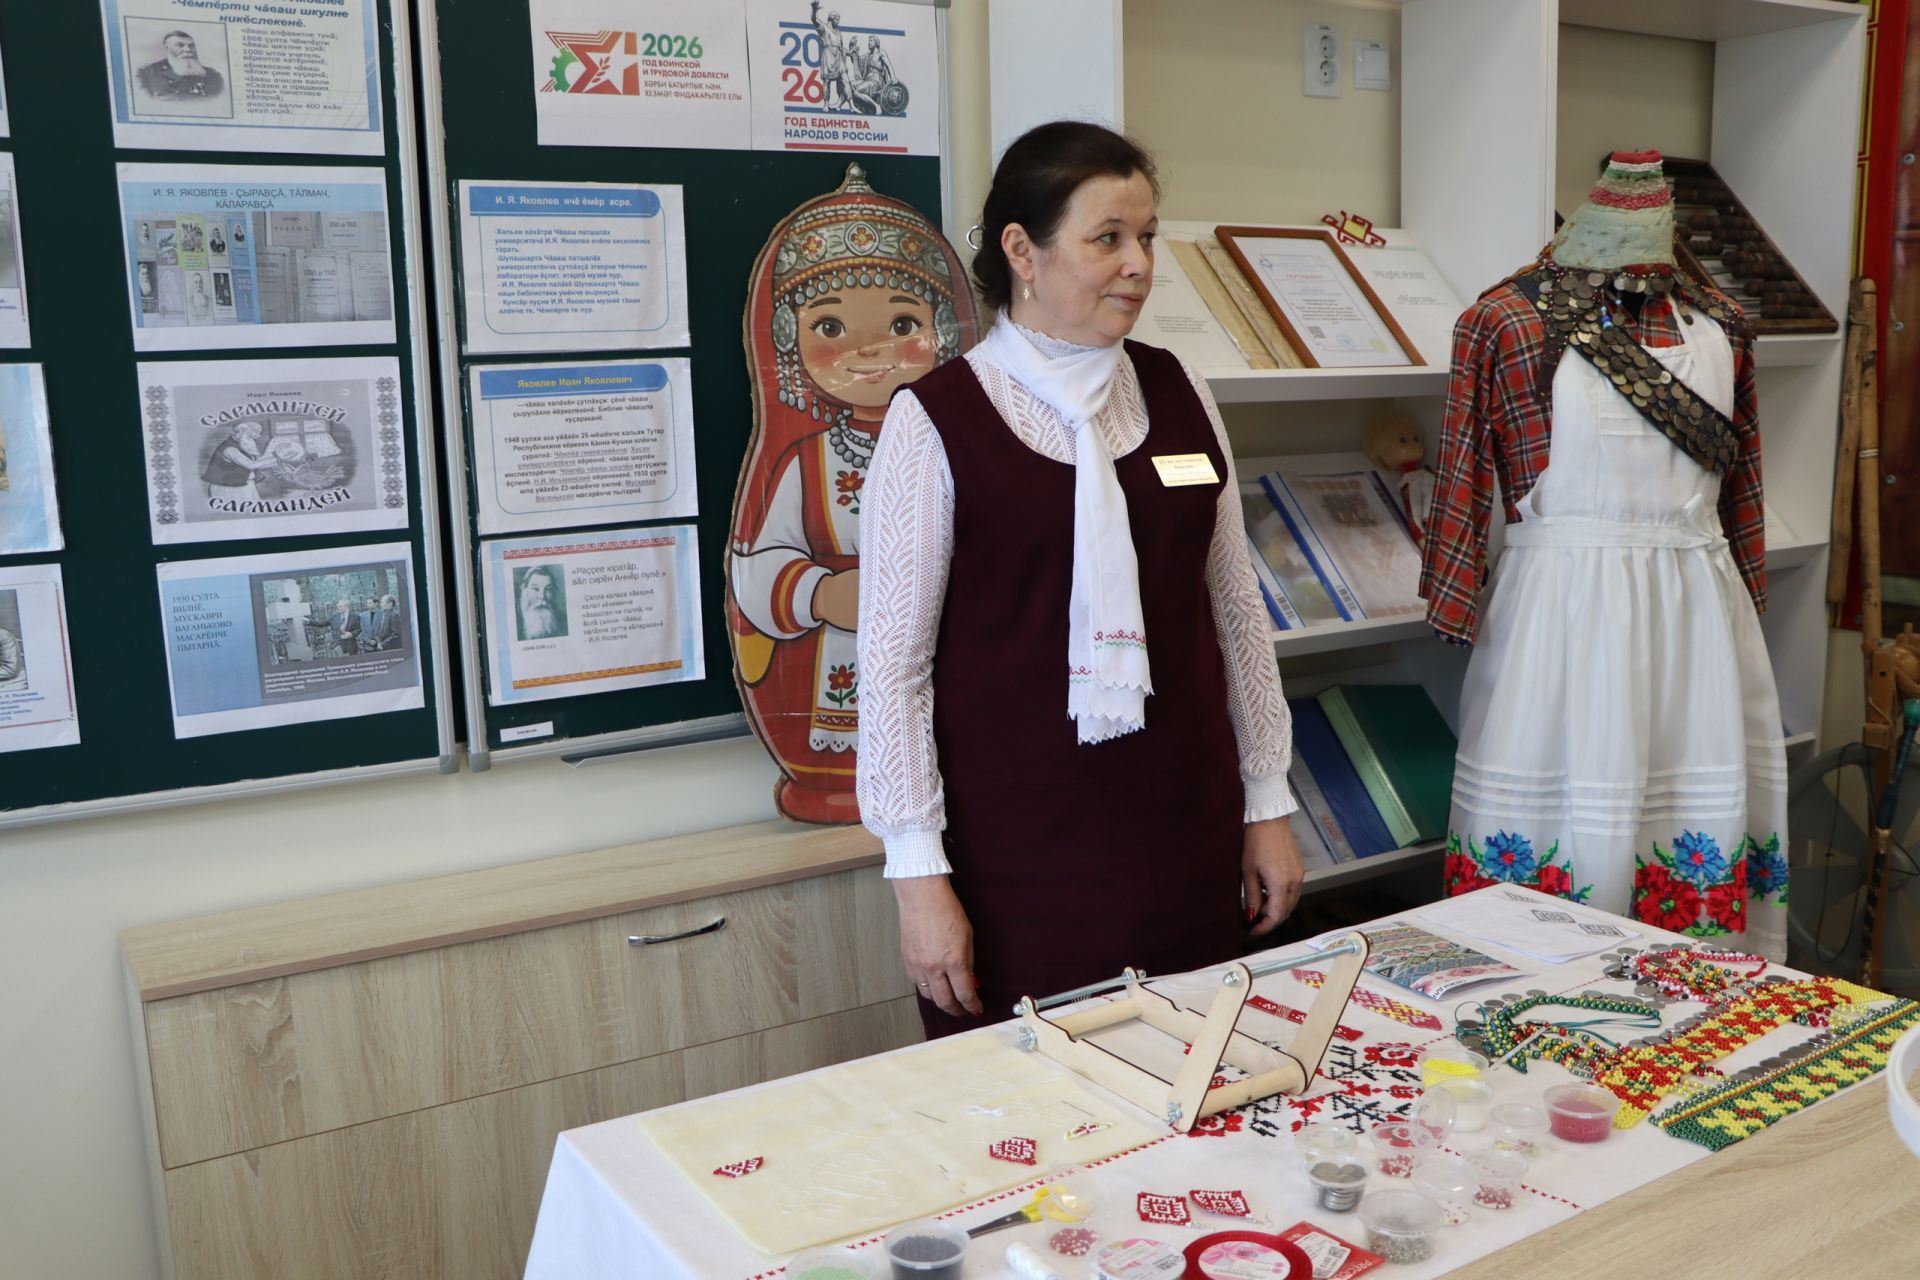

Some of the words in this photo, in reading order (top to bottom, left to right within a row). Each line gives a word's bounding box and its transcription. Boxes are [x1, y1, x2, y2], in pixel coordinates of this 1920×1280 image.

[301, 8, 349, 19] шкулне
[642, 33, 703, 59] 2026
[780, 32, 824, 68] 20
[642, 59, 657, 67] ГОД
[659, 60, 700, 68] ВОИНСКОЙ
[650, 69, 689, 77] ТРУДОВОЙ
[782, 67, 824, 104] 26
[785, 117, 807, 127] ГОД
[811, 118, 870, 129] ЕДИНСТВА
[785, 130, 839, 140] НАРОДОВ
[843, 131, 888, 141] РОССИИ
[167, 189, 175, 197] Я.
[180, 188, 227, 197] ЯКОВЛЕВ
[496, 196, 505, 204] И.
[508, 196, 517, 204] Я.
[520, 196, 559, 205] Яковлев
[609, 199, 632, 207] асра.
[559, 378, 581, 386] Иван
